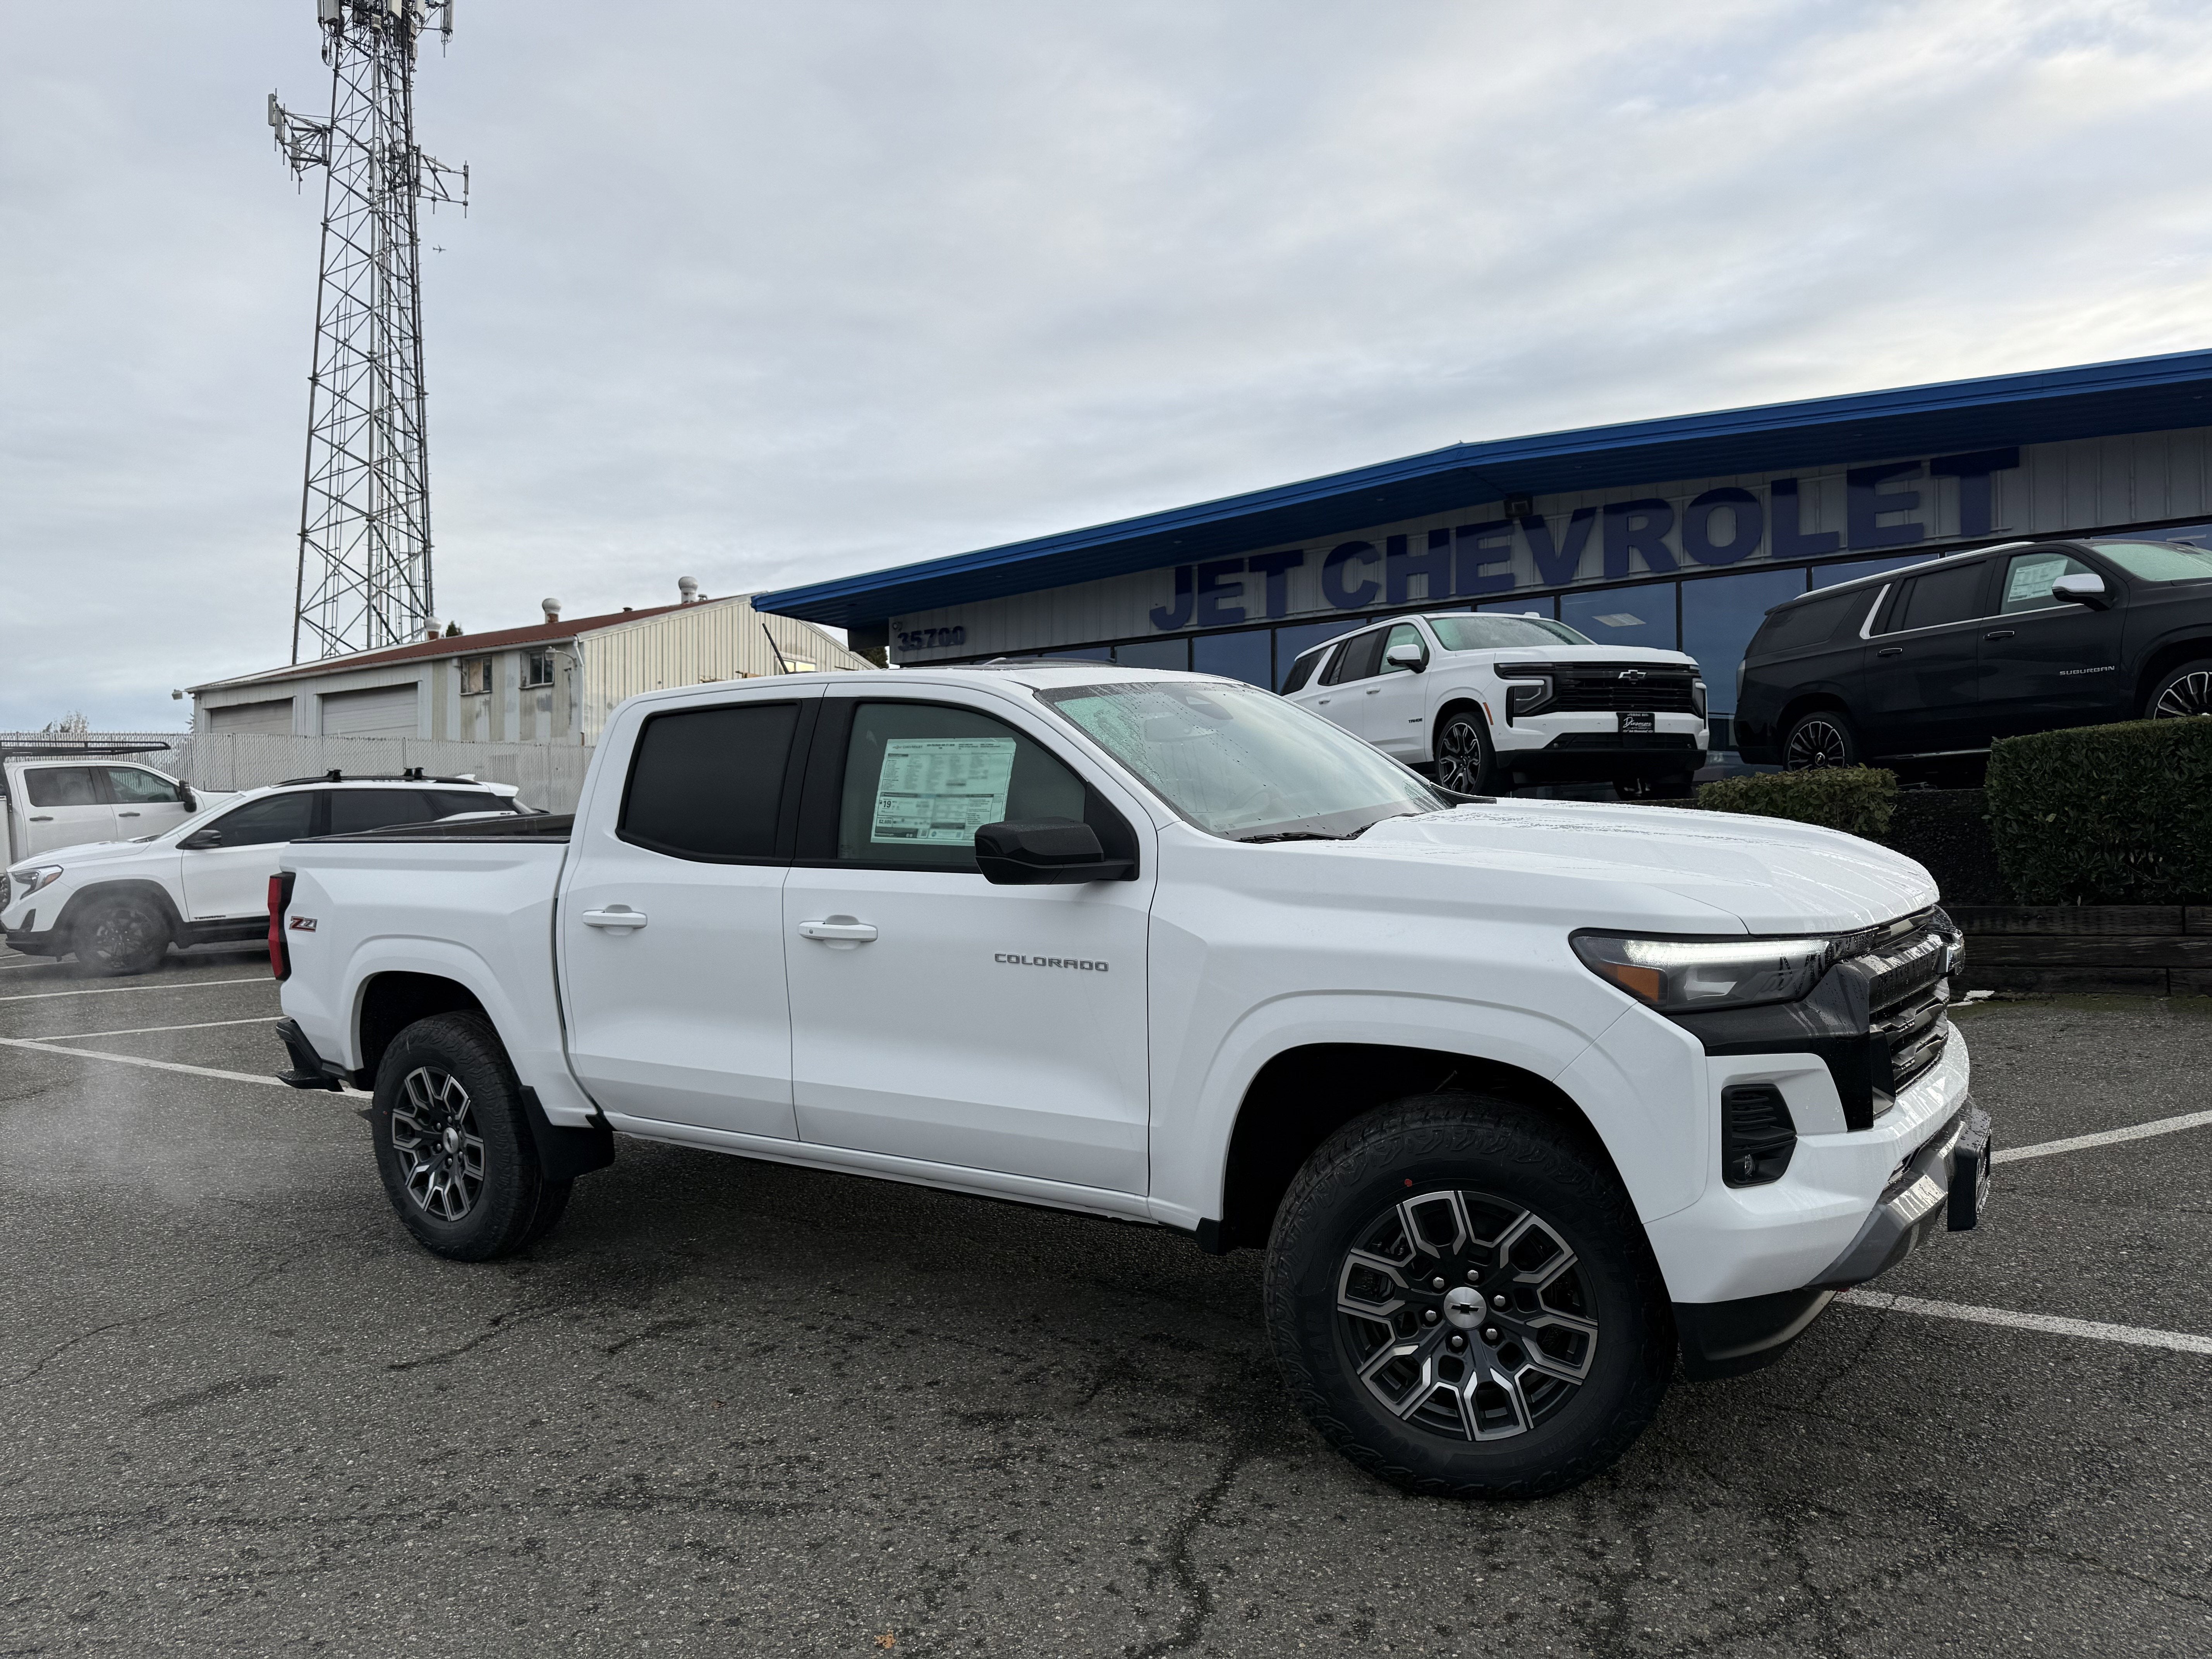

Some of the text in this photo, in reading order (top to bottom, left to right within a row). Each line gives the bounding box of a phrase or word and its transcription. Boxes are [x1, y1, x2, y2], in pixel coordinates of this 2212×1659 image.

[1149, 446, 2020, 630] JET CHEVROLET
[897, 625, 966, 652] 35700
[2059, 665, 2115, 676] SUBURBAN
[289, 915, 318, 933] Z71
[994, 952, 1109, 971] COLORADO
